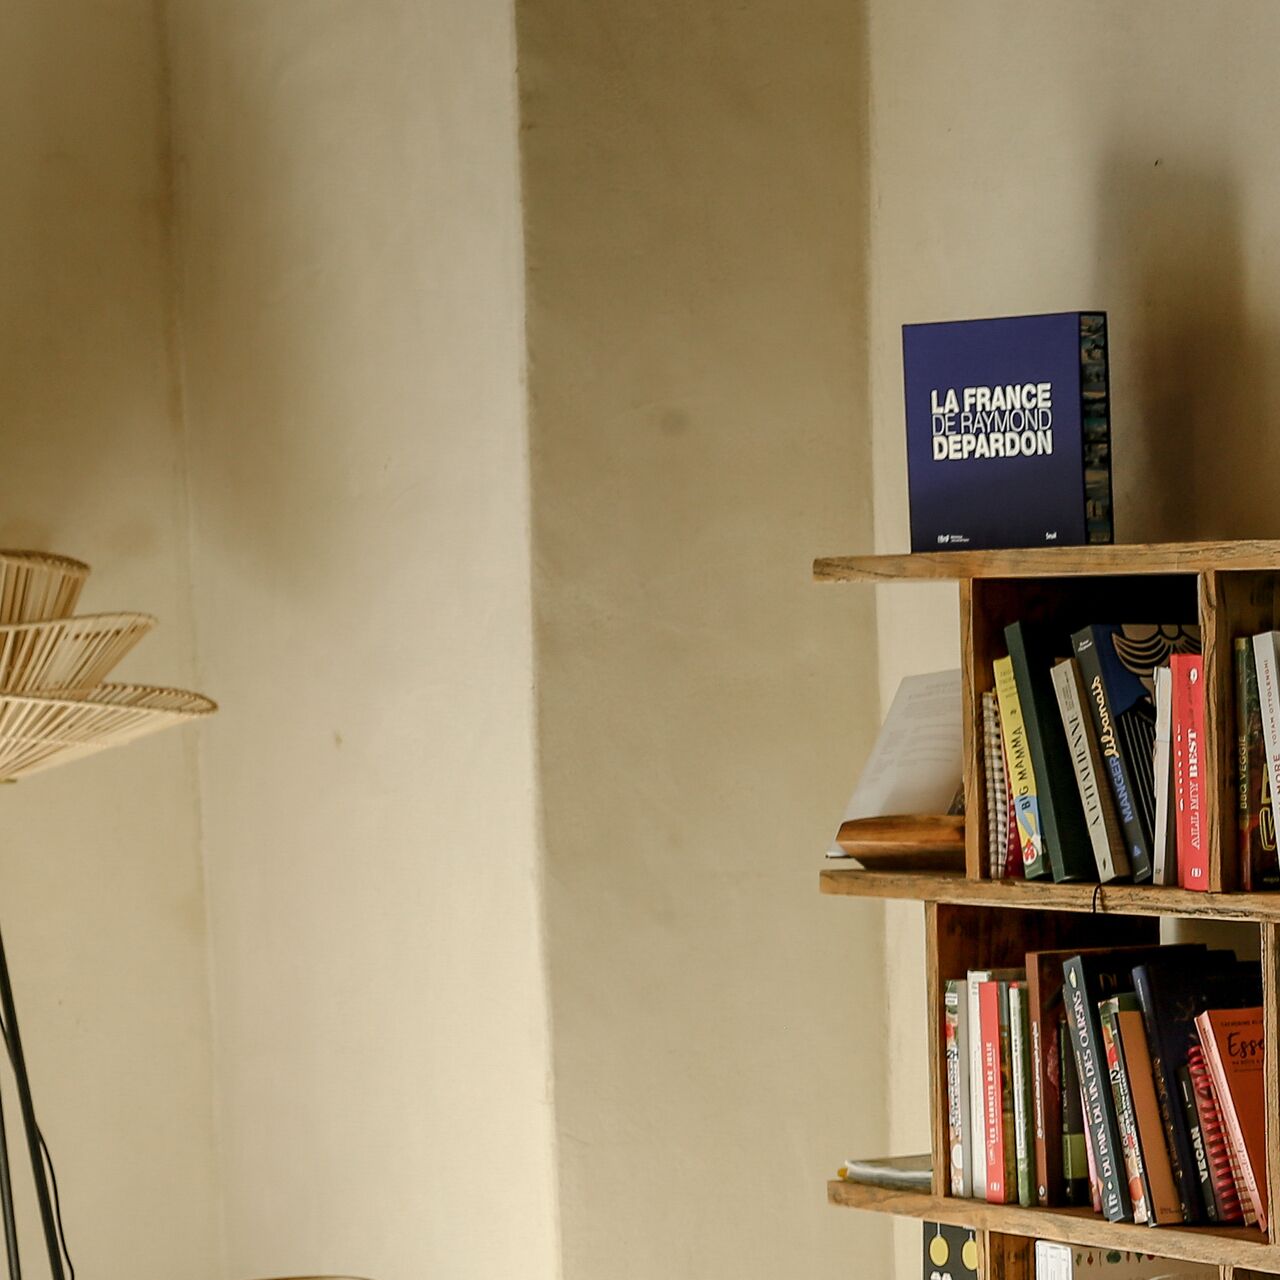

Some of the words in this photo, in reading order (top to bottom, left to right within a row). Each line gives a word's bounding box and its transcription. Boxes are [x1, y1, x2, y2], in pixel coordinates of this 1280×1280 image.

[931, 388, 960, 414] LA
[963, 383, 1052, 411] FRANCE
[932, 413, 957, 436] DE
[960, 408, 1052, 434] RAYMOND
[932, 430, 1053, 460] DEPARDON
[1263, 659, 1276, 715] OTTOLENGHI
[1090, 675, 1119, 758] libanais
[1270, 716, 1278, 745] YOTAM
[1011, 726, 1029, 784] MAMMA
[1187, 728, 1199, 777] BEST
[1238, 735, 1247, 781] VEGGIE
[1016, 784, 1031, 810] BIG
[1108, 756, 1134, 823] MANGER
[1240, 786, 1248, 809] BBQ
[1072, 991, 1090, 1048] OURSINS
[987, 1070, 993, 1082] DE
[1083, 1050, 1095, 1077] DES
[987, 1084, 995, 1120] CARNETS
[1092, 1103, 1103, 1124] DU
[1102, 1158, 1112, 1177] DU
[1190, 1126, 1206, 1183] VEGAN
